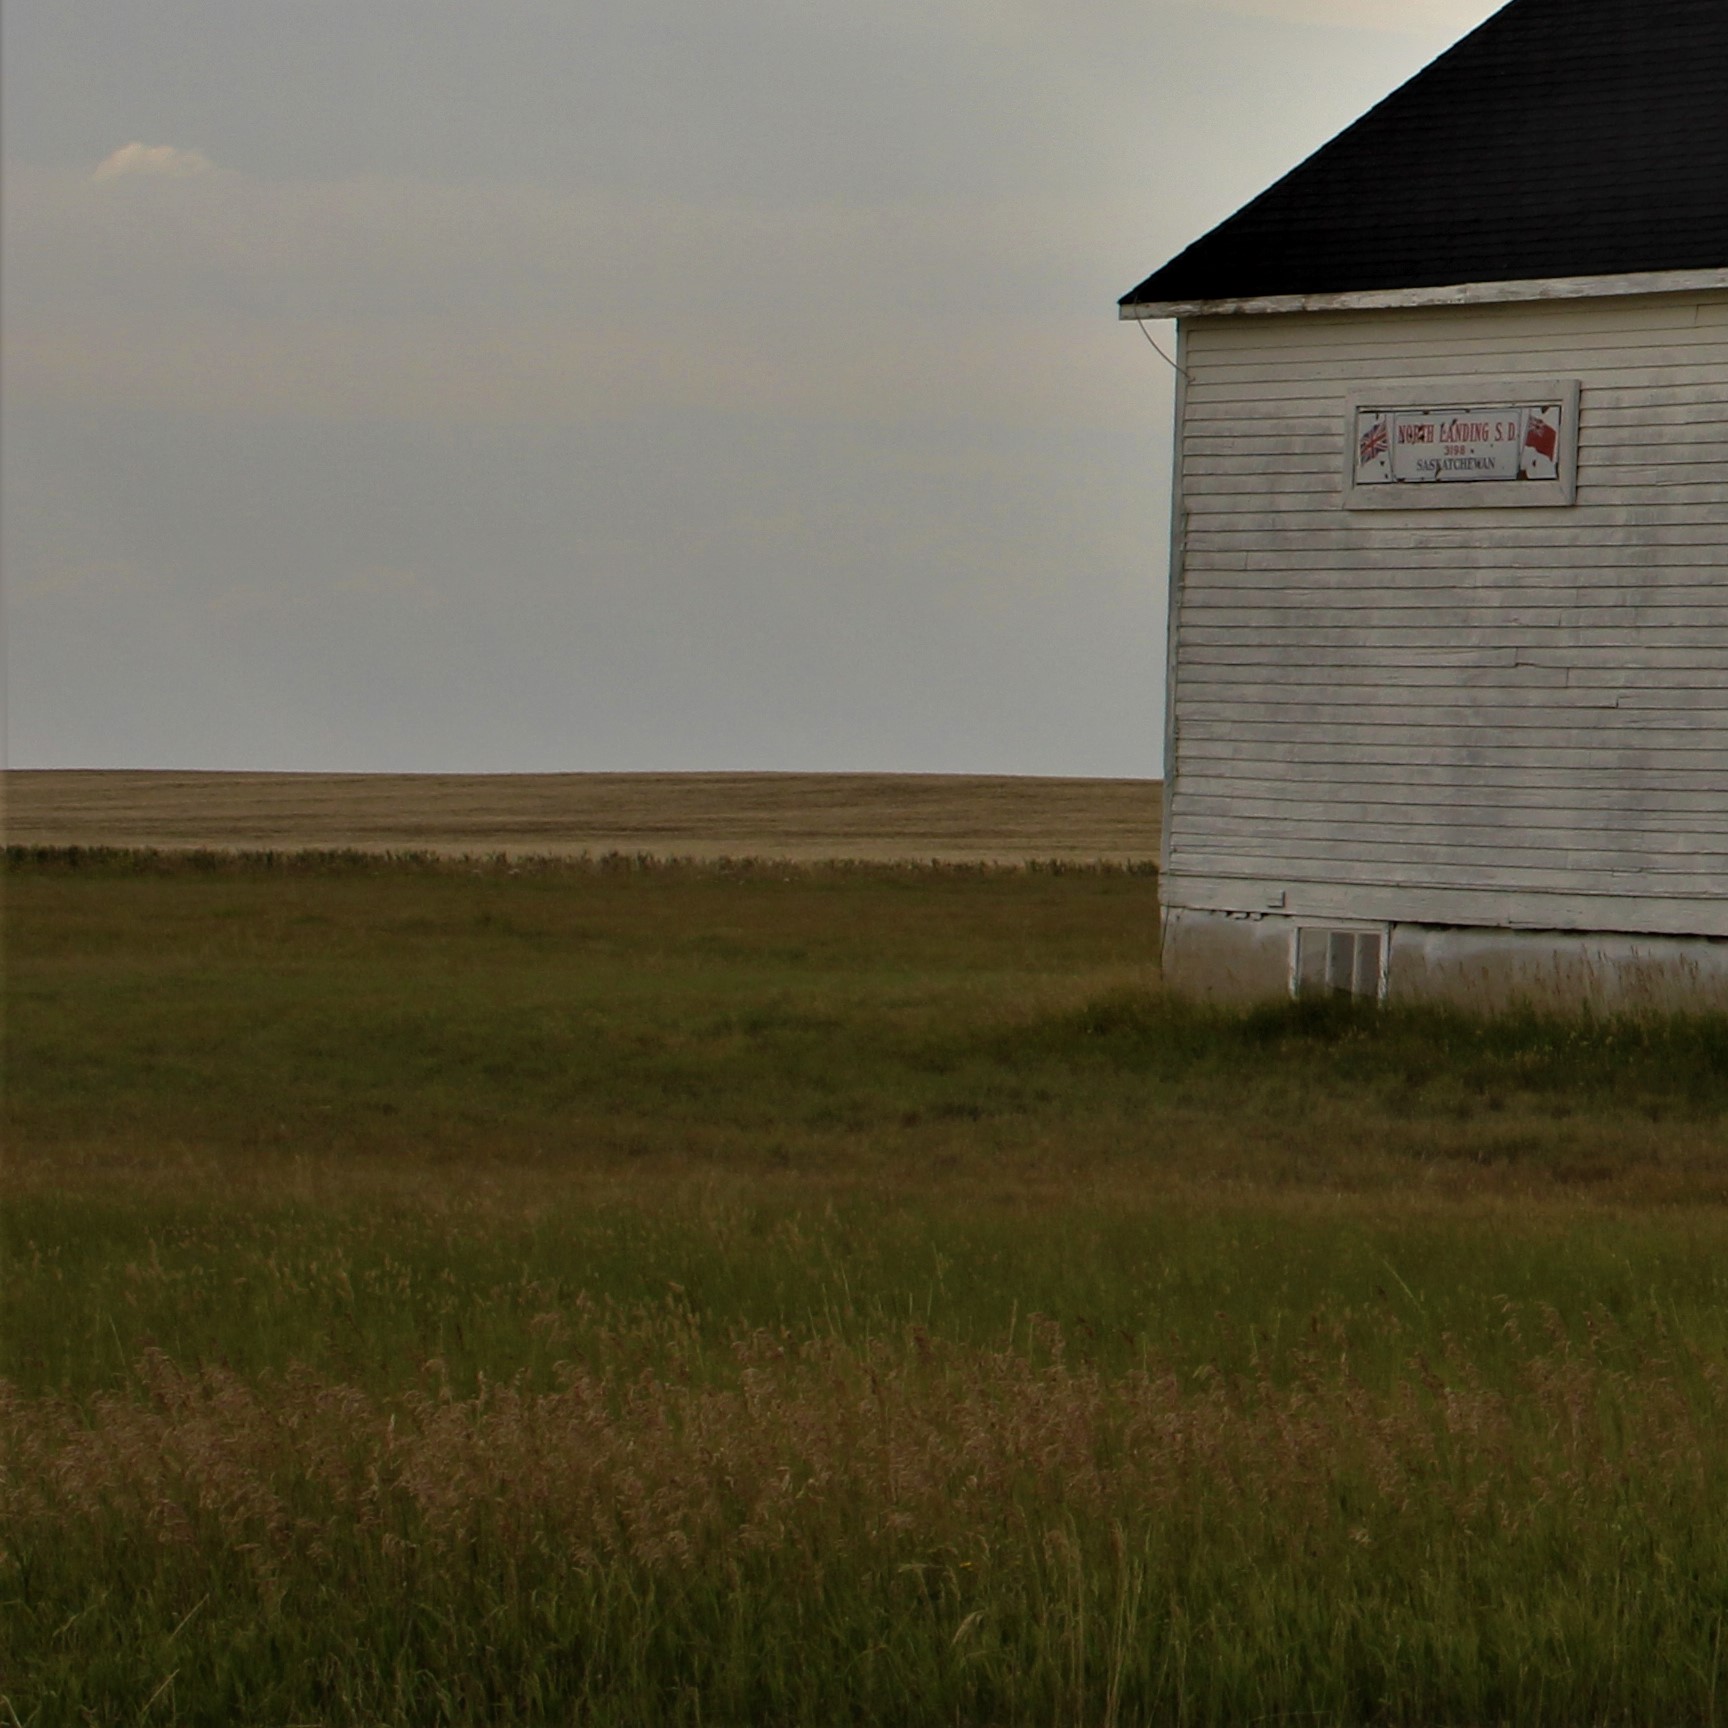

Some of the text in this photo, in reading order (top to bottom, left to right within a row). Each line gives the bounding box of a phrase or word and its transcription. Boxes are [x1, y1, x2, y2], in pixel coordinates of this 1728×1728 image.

[1398, 424, 1435, 444] NORTH
[1440, 422, 1489, 442] LANDING
[1444, 445, 1466, 455] 3198
[1416, 457, 1497, 471] SASKATCHEWAN
